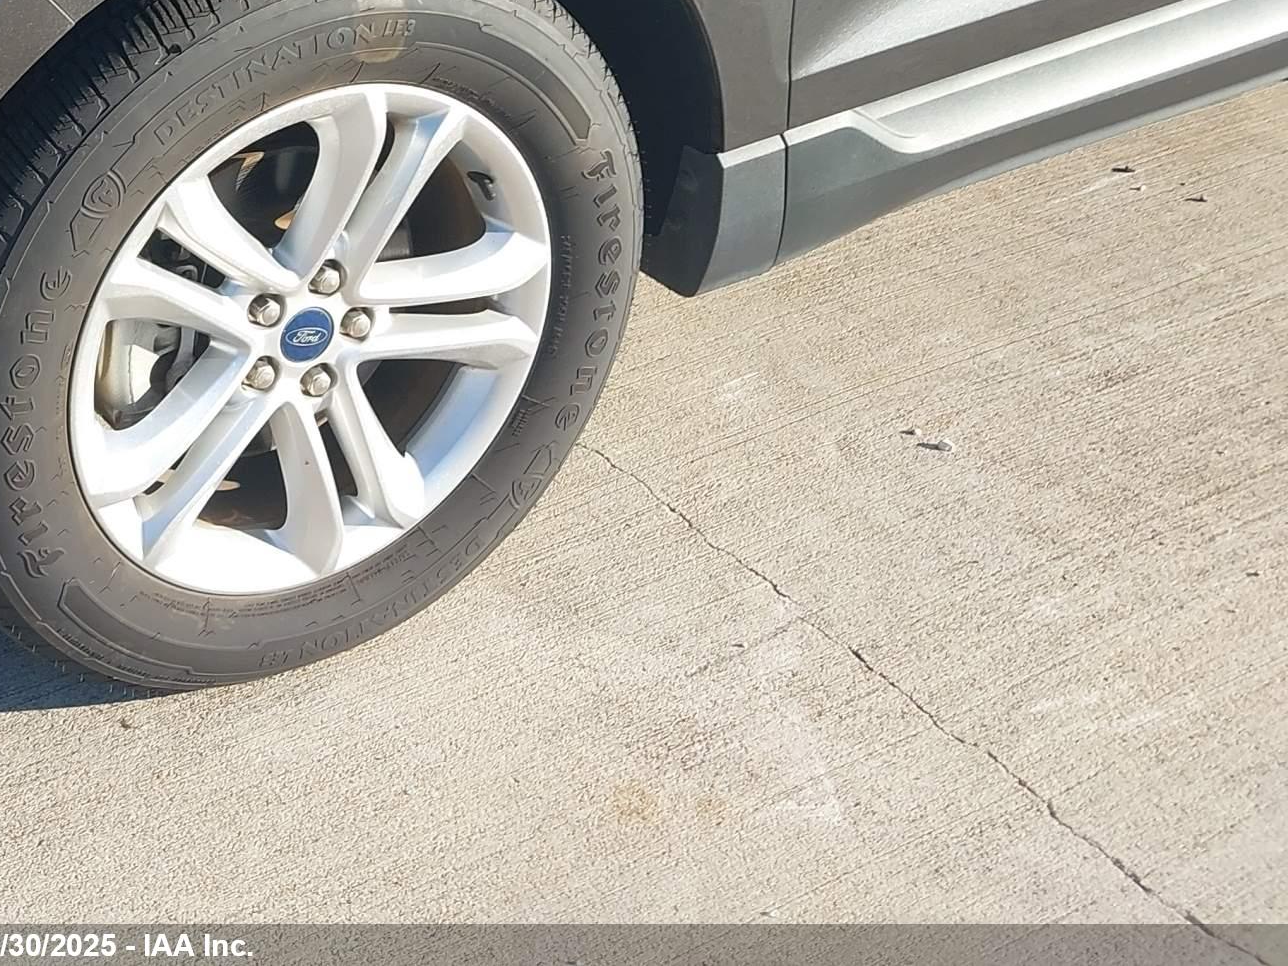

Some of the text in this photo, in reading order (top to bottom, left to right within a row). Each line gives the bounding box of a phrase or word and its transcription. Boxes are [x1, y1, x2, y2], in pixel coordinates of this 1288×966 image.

[153, 20, 375, 146] DESTINATION
[293, 330, 322, 343] Ford
[554, 148, 622, 432] Firestone
